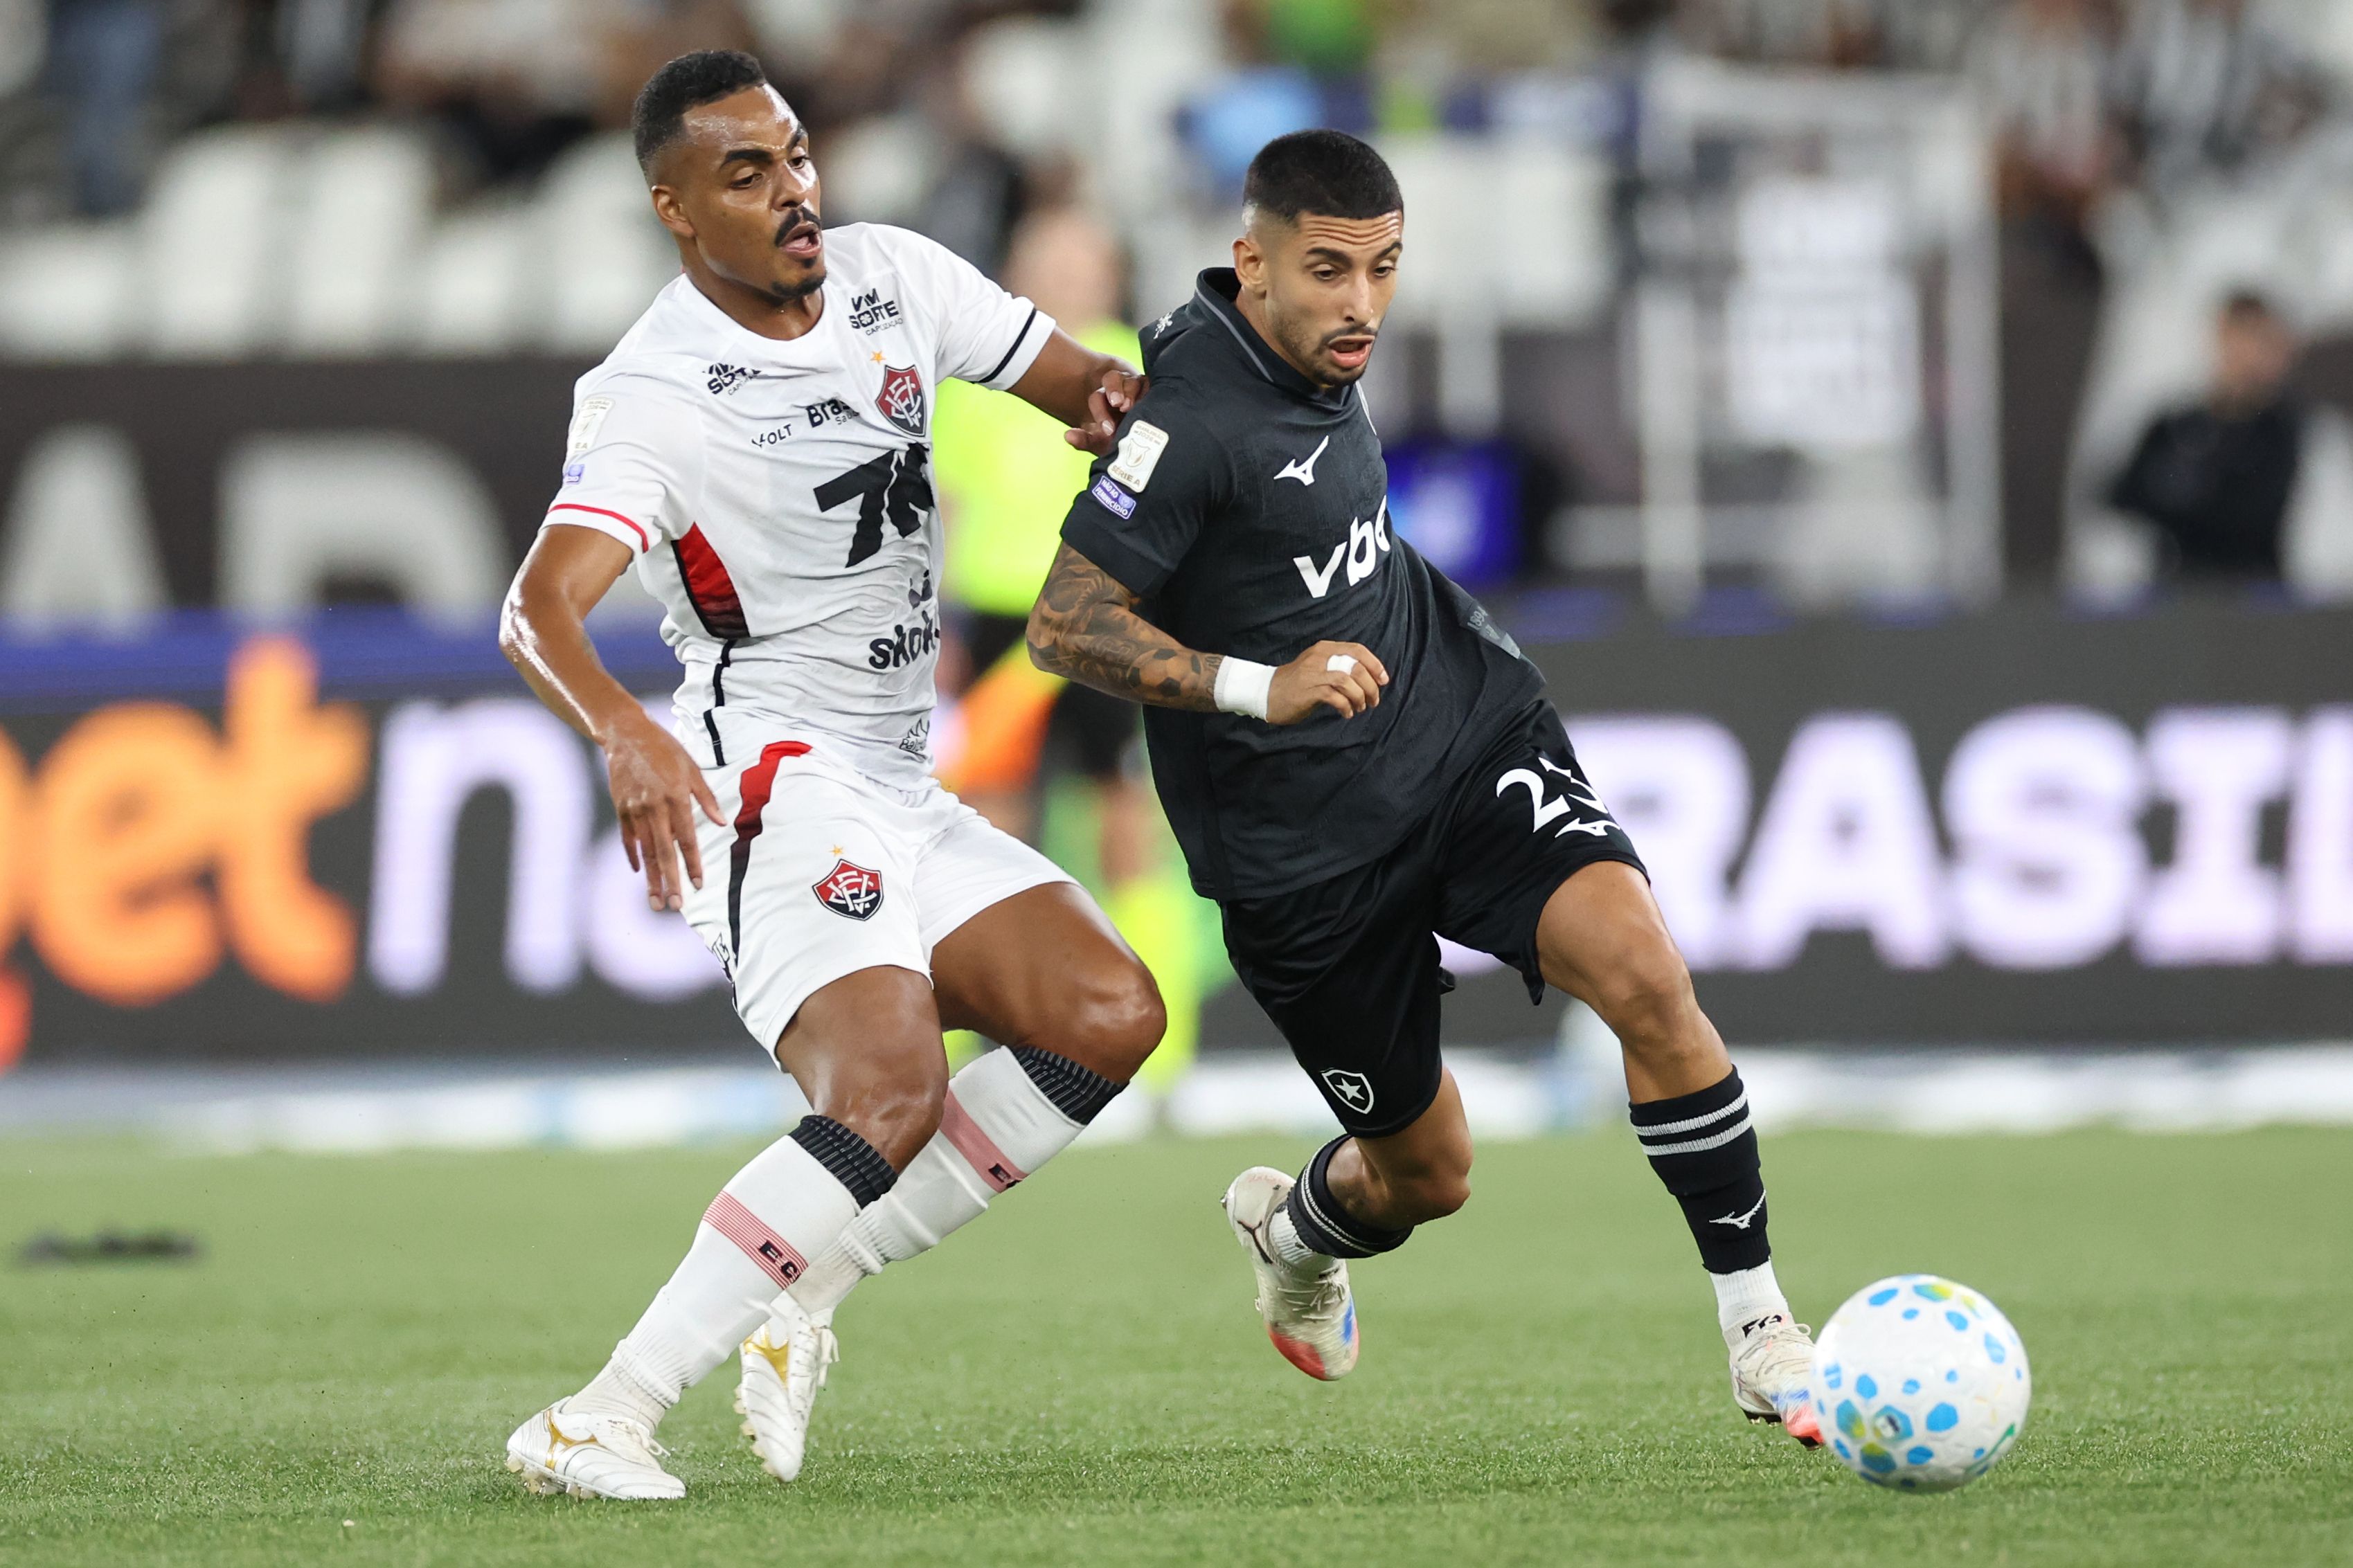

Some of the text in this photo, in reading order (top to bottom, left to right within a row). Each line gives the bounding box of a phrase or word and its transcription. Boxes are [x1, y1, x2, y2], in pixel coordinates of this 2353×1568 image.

[751, 424, 792, 447] VOLT
[1111, 465, 1141, 487] SÉRIE A
